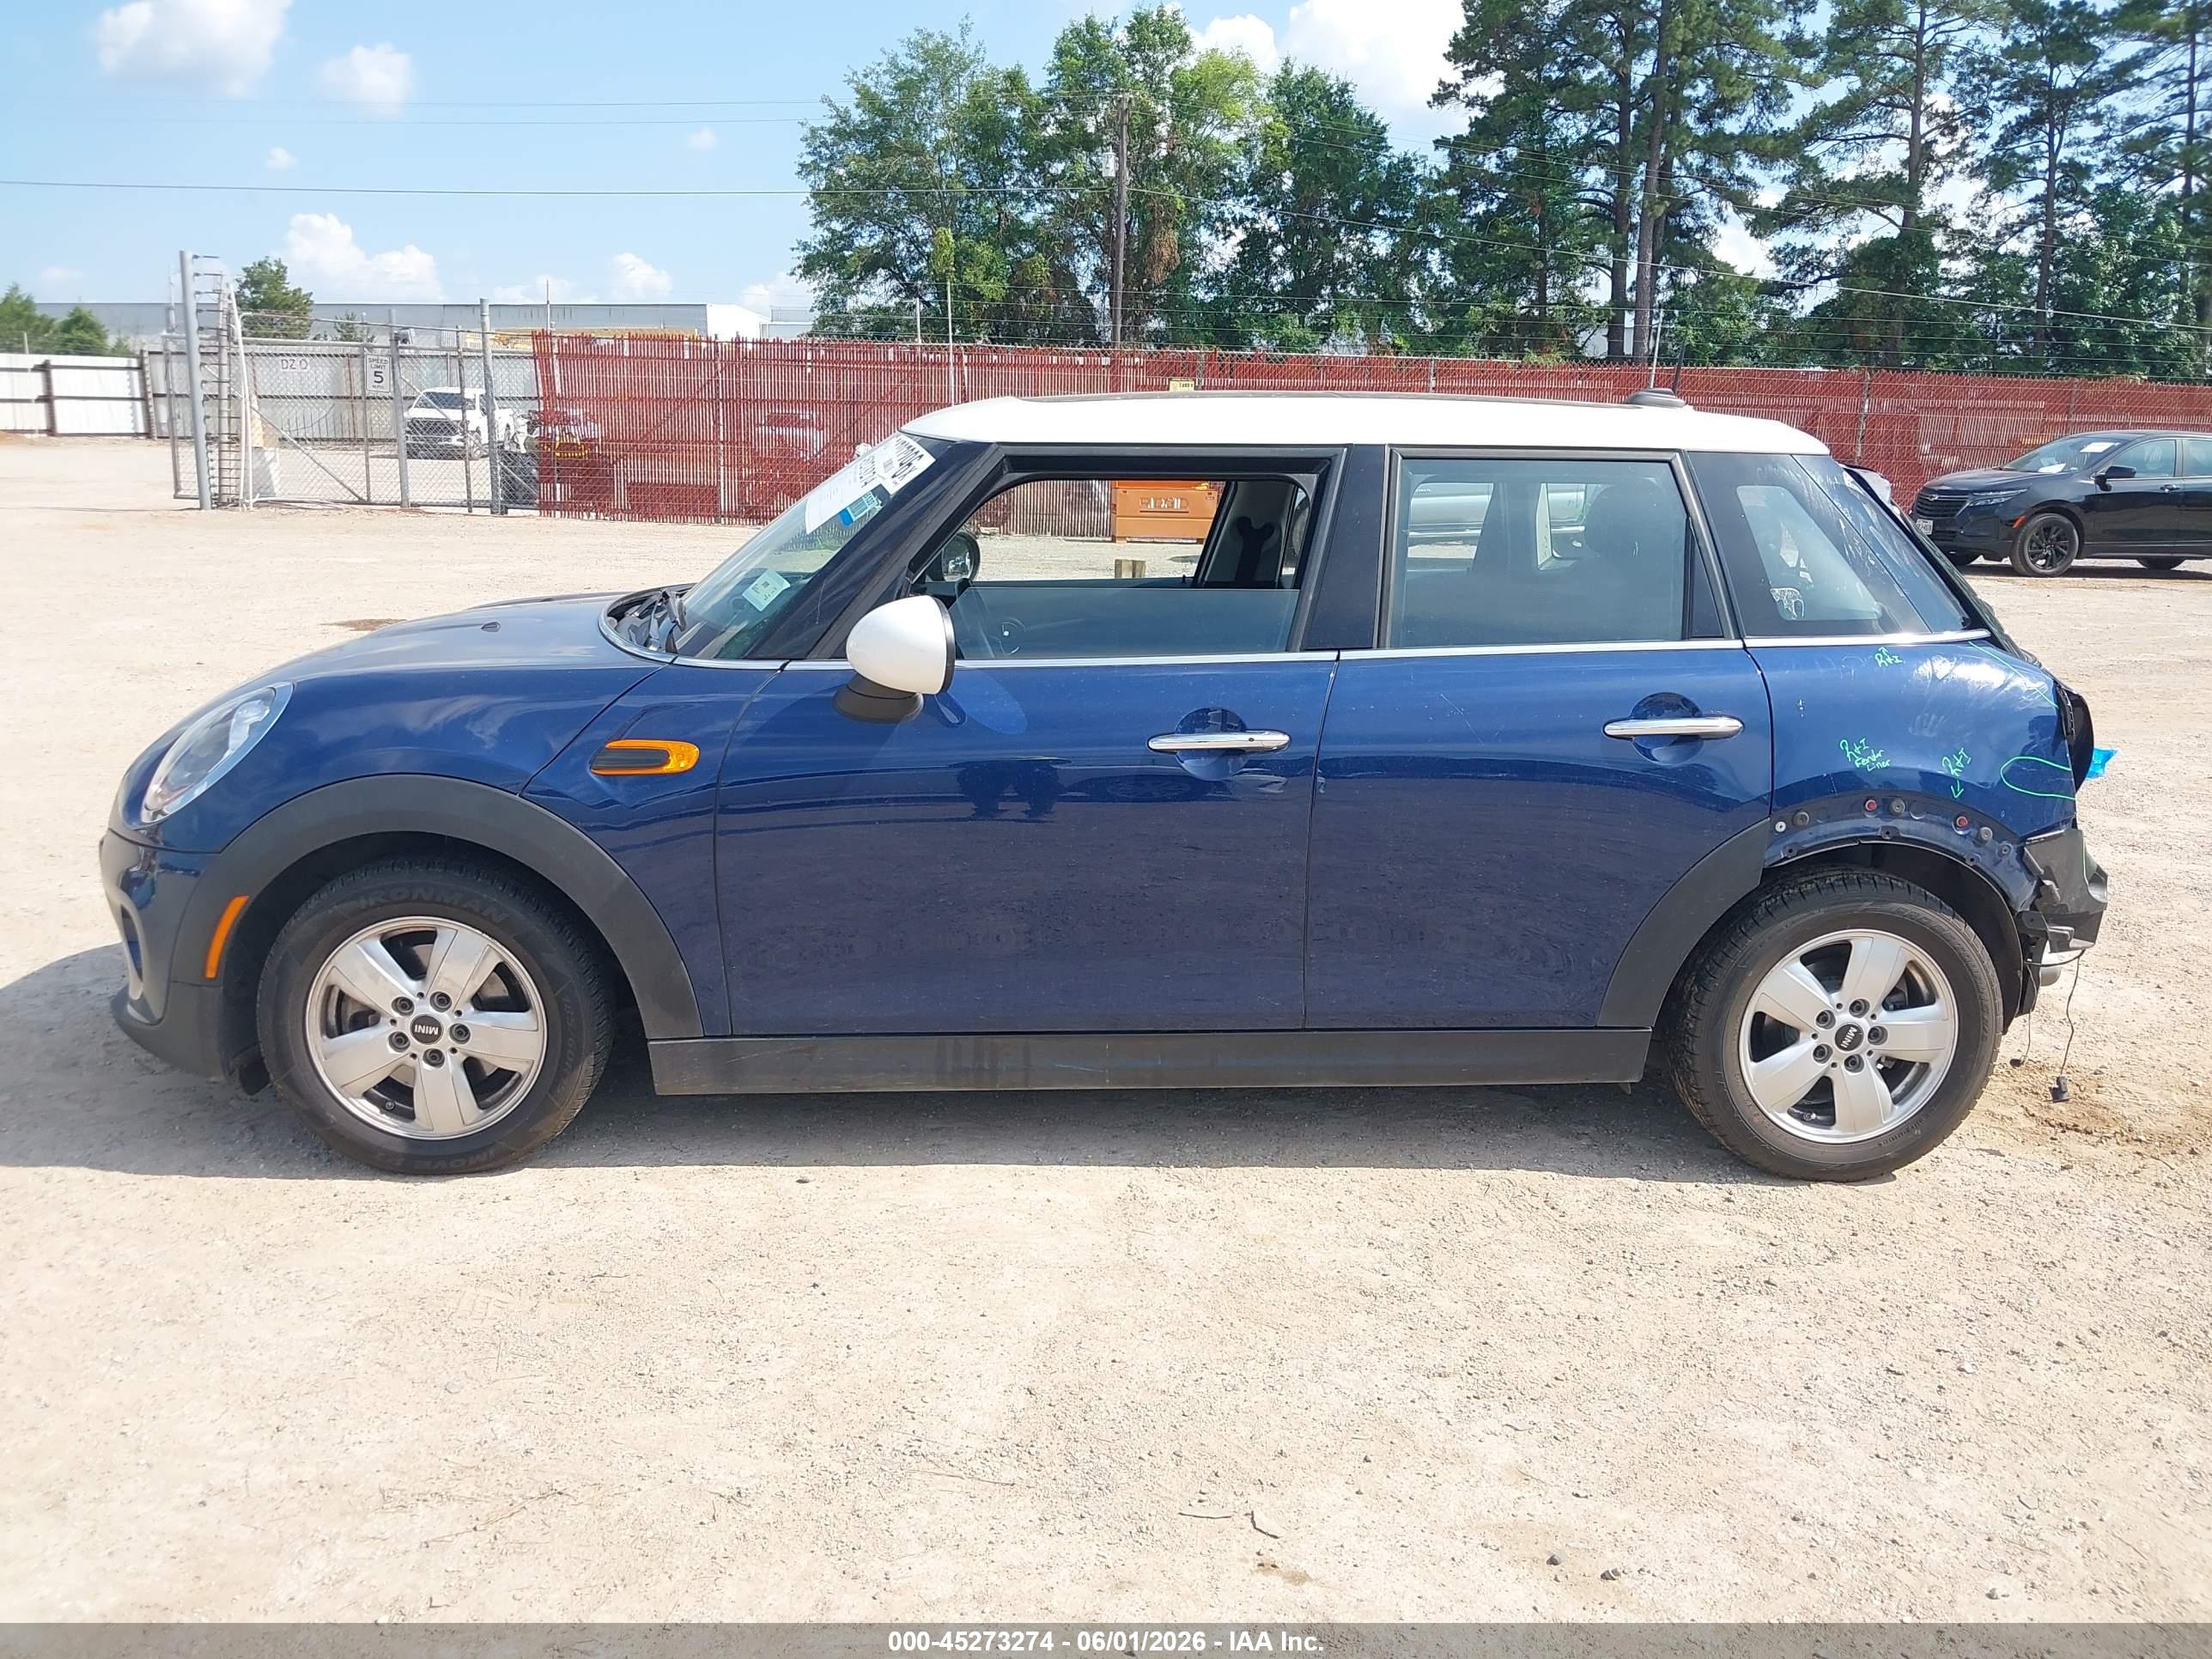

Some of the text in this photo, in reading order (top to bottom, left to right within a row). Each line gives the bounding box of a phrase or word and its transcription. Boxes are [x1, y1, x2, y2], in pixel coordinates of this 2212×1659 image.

[374, 371, 384, 384] 5
[414, 1024, 439, 1036] MINI
[1840, 1026, 1857, 1048] MINI
